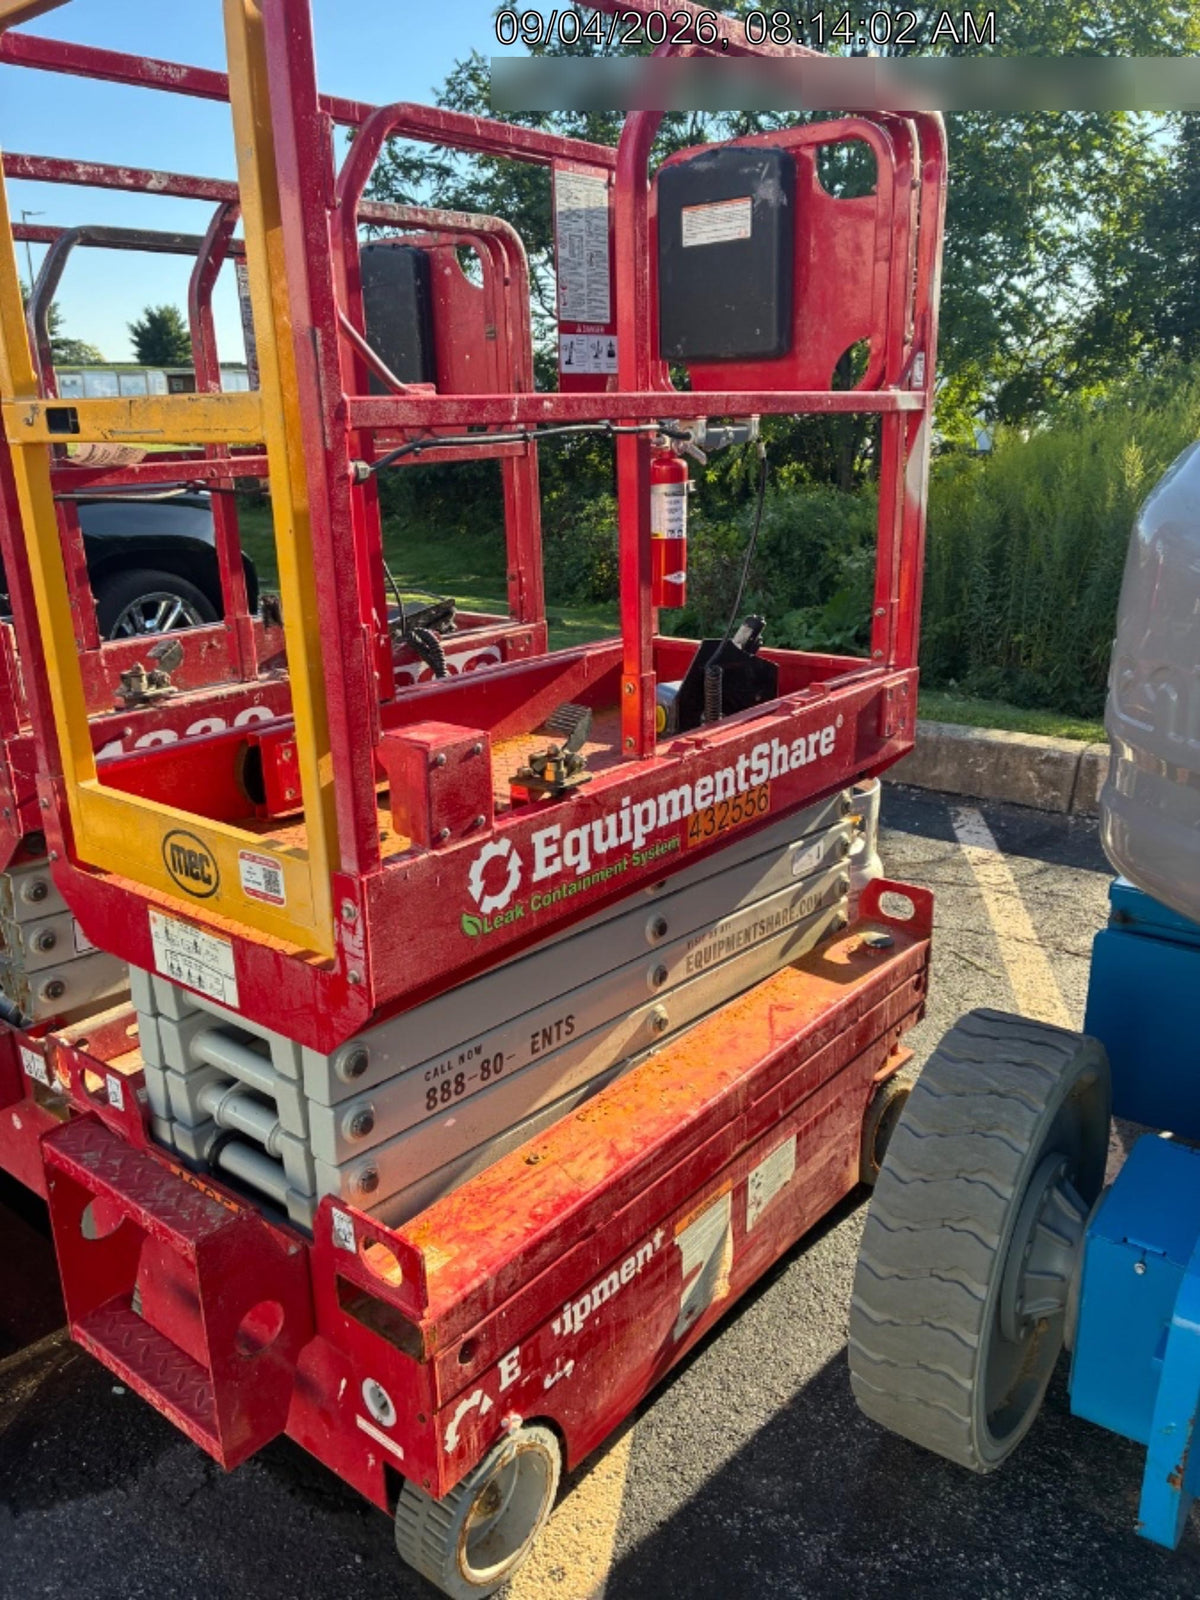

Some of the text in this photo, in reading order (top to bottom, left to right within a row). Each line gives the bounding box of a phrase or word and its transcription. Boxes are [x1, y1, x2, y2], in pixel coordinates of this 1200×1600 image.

[689, 783, 769, 839] 432556
[482, 836, 680, 934] Leak Containment System
[686, 892, 823, 974] EQUIPMENTSHARE.COM
[424, 1043, 483, 1082] CALL NOW
